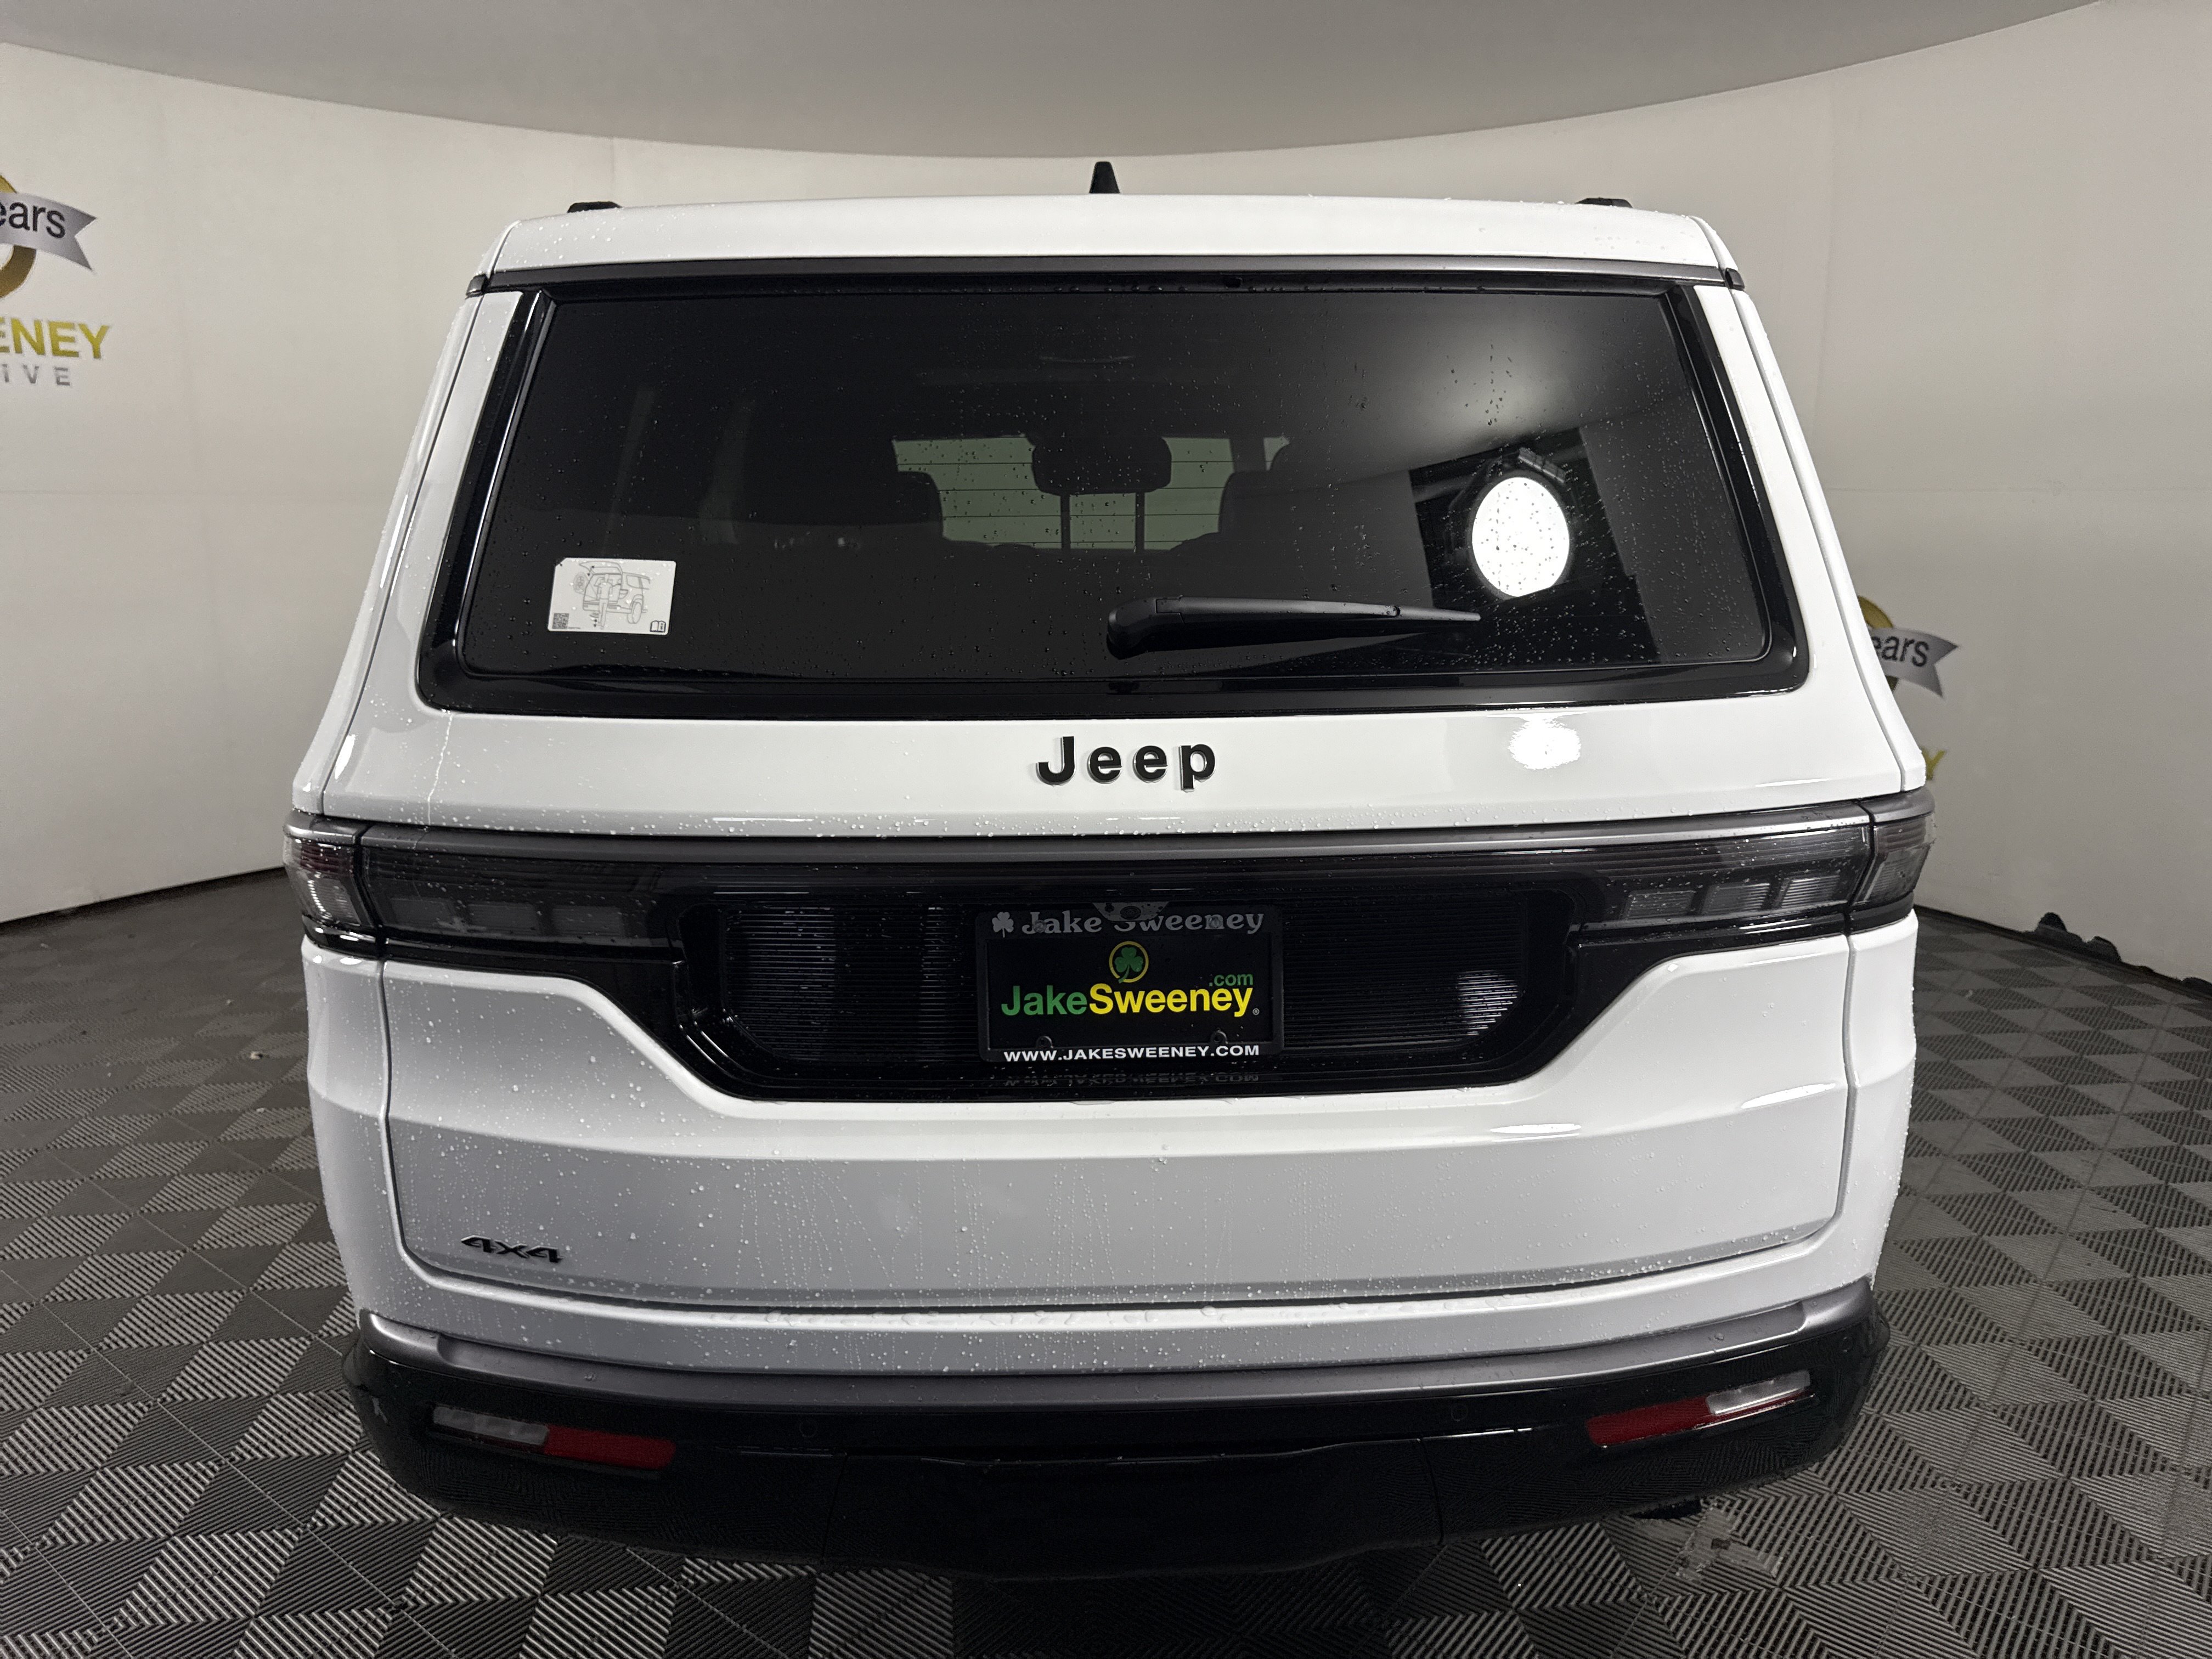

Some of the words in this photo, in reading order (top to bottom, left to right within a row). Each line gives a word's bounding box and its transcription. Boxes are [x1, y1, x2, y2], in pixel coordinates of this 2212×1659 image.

[1036, 736, 1216, 792] Jeep
[1022, 910, 1102, 934] Jake
[1003, 1045, 1260, 1062] WWW.JAKESWEENEY.COM
